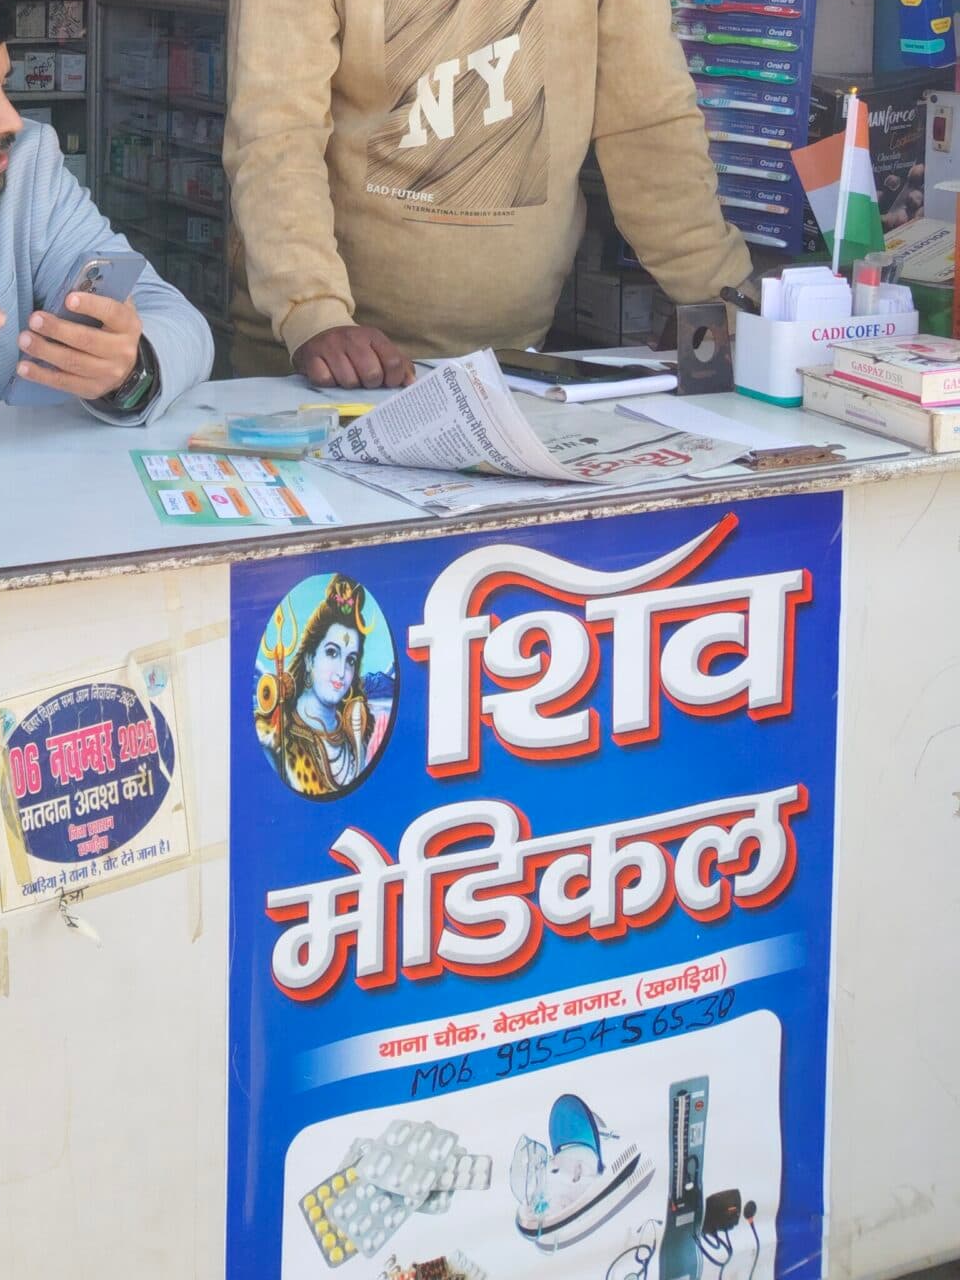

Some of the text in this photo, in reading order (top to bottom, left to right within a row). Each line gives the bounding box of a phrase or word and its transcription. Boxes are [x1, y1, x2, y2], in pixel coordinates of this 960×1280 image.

[768, 28, 793, 37] Oral-B
[766, 61, 791, 70] Oral-B
[398, 34, 521, 149] NY
[764, 94, 789, 103] Oral-B
[761, 126, 785, 136] Oral-B
[759, 159, 784, 169] Oral-B
[366, 183, 434, 203] BAD FUTURE
[758, 192, 782, 201] Oral-B
[756, 224, 781, 234] Oral-B
[812, 323, 896, 342] CADICOFF-D
[851, 360, 884, 380] GASPAZ
[407, 511, 813, 779] शिव
[9, 719, 159, 799] 06 नवम्बर 2025
[20, 796, 72, 834] मतदान
[74, 785, 120, 816] अवश्य
[103, 856, 119, 872] वोट
[120, 848, 135, 867] देने
[136, 845, 158, 861] जाना
[265, 783, 809, 1001] मेडिकल
[379, 956, 728, 1059] थाना चौक, बेलदौर बाजार, (खगड़िया)
